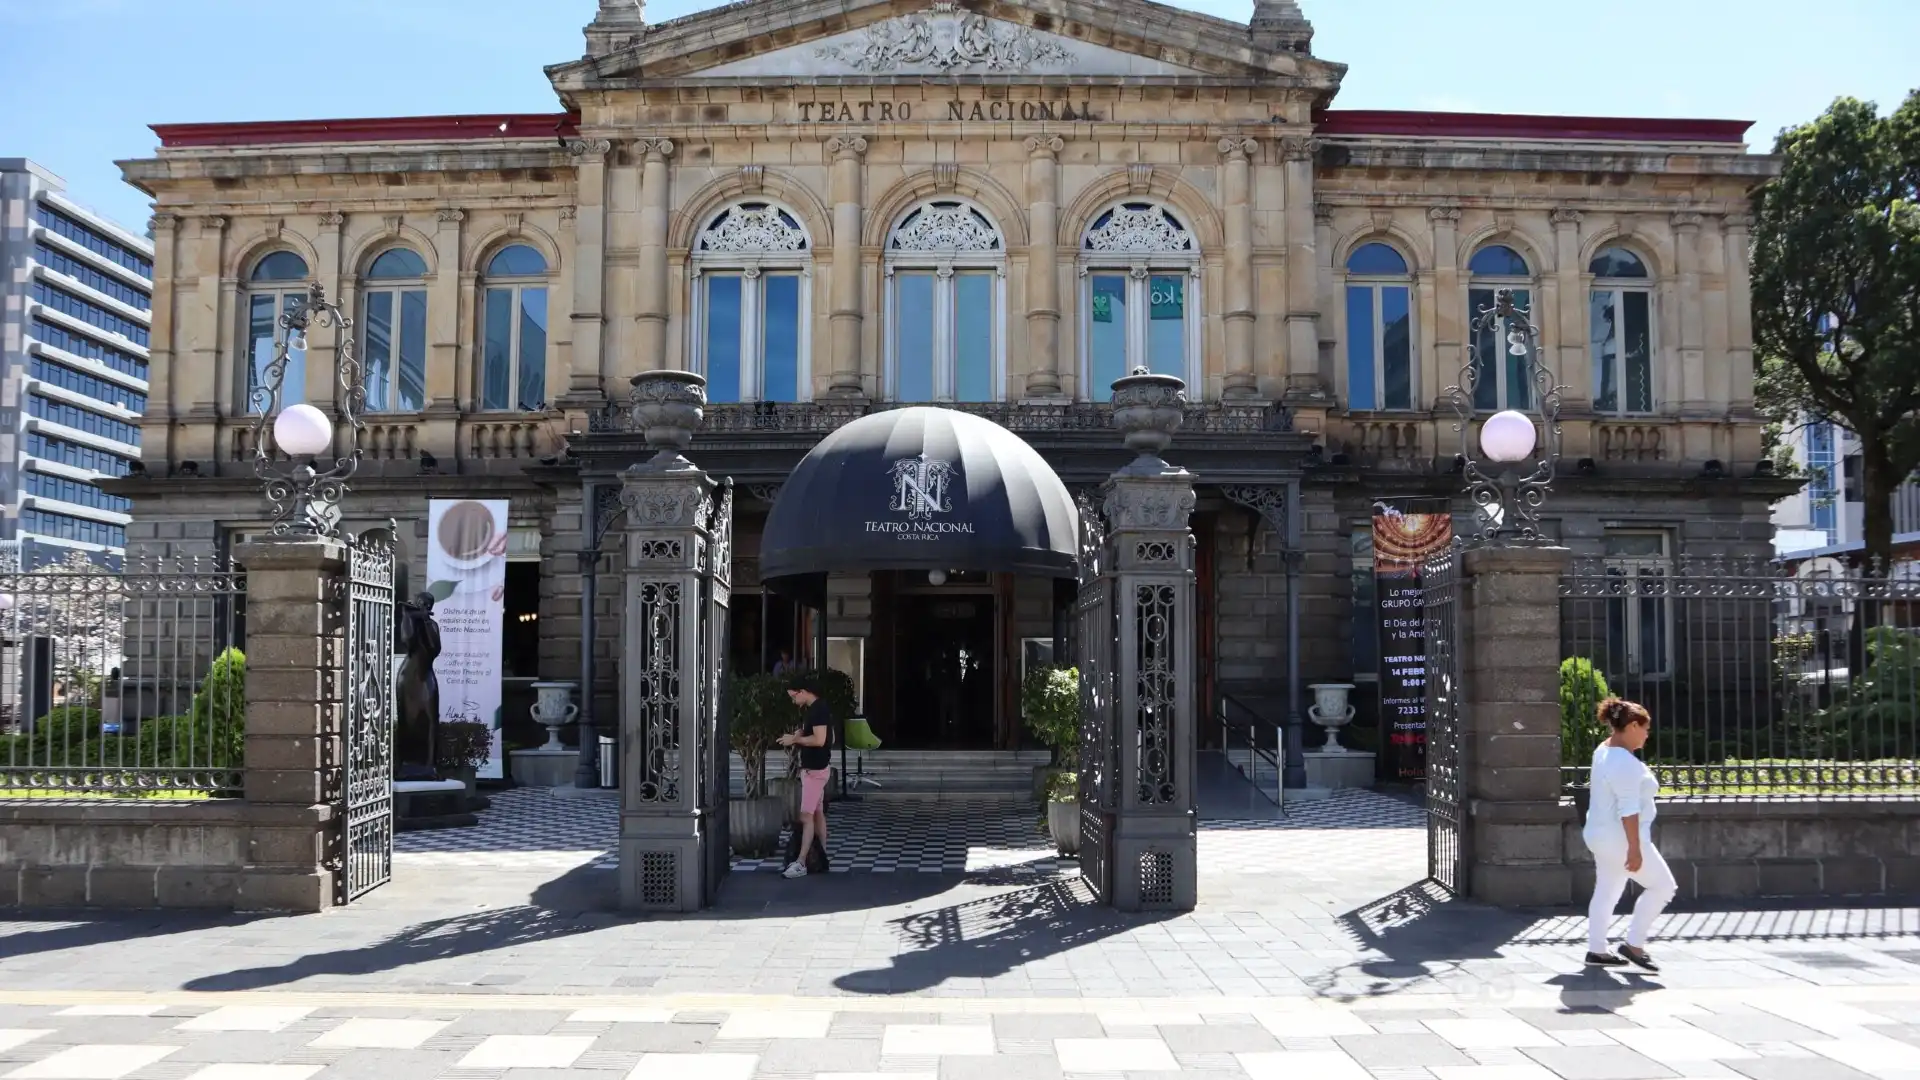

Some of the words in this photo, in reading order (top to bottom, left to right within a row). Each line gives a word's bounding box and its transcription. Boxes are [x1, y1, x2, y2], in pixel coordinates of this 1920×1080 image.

[798, 101, 911, 121] TEATRO
[948, 101, 1094, 121] NACIONAL
[865, 522, 909, 532] TEATRO
[914, 522, 975, 533] NACIONAL
[1389, 589, 1399, 597] Lo
[1401, 588, 1423, 598] mejor
[1382, 600, 1410, 608] GRUPO
[1384, 619, 1391, 627] El
[1393, 618, 1407, 627] Día
[1409, 618, 1420, 627] del
[1391, 632, 1397, 640] y
[1398, 630, 1407, 638] la
[1383, 697, 1410, 705] Informes
[1398, 706, 1418, 714] 7233
